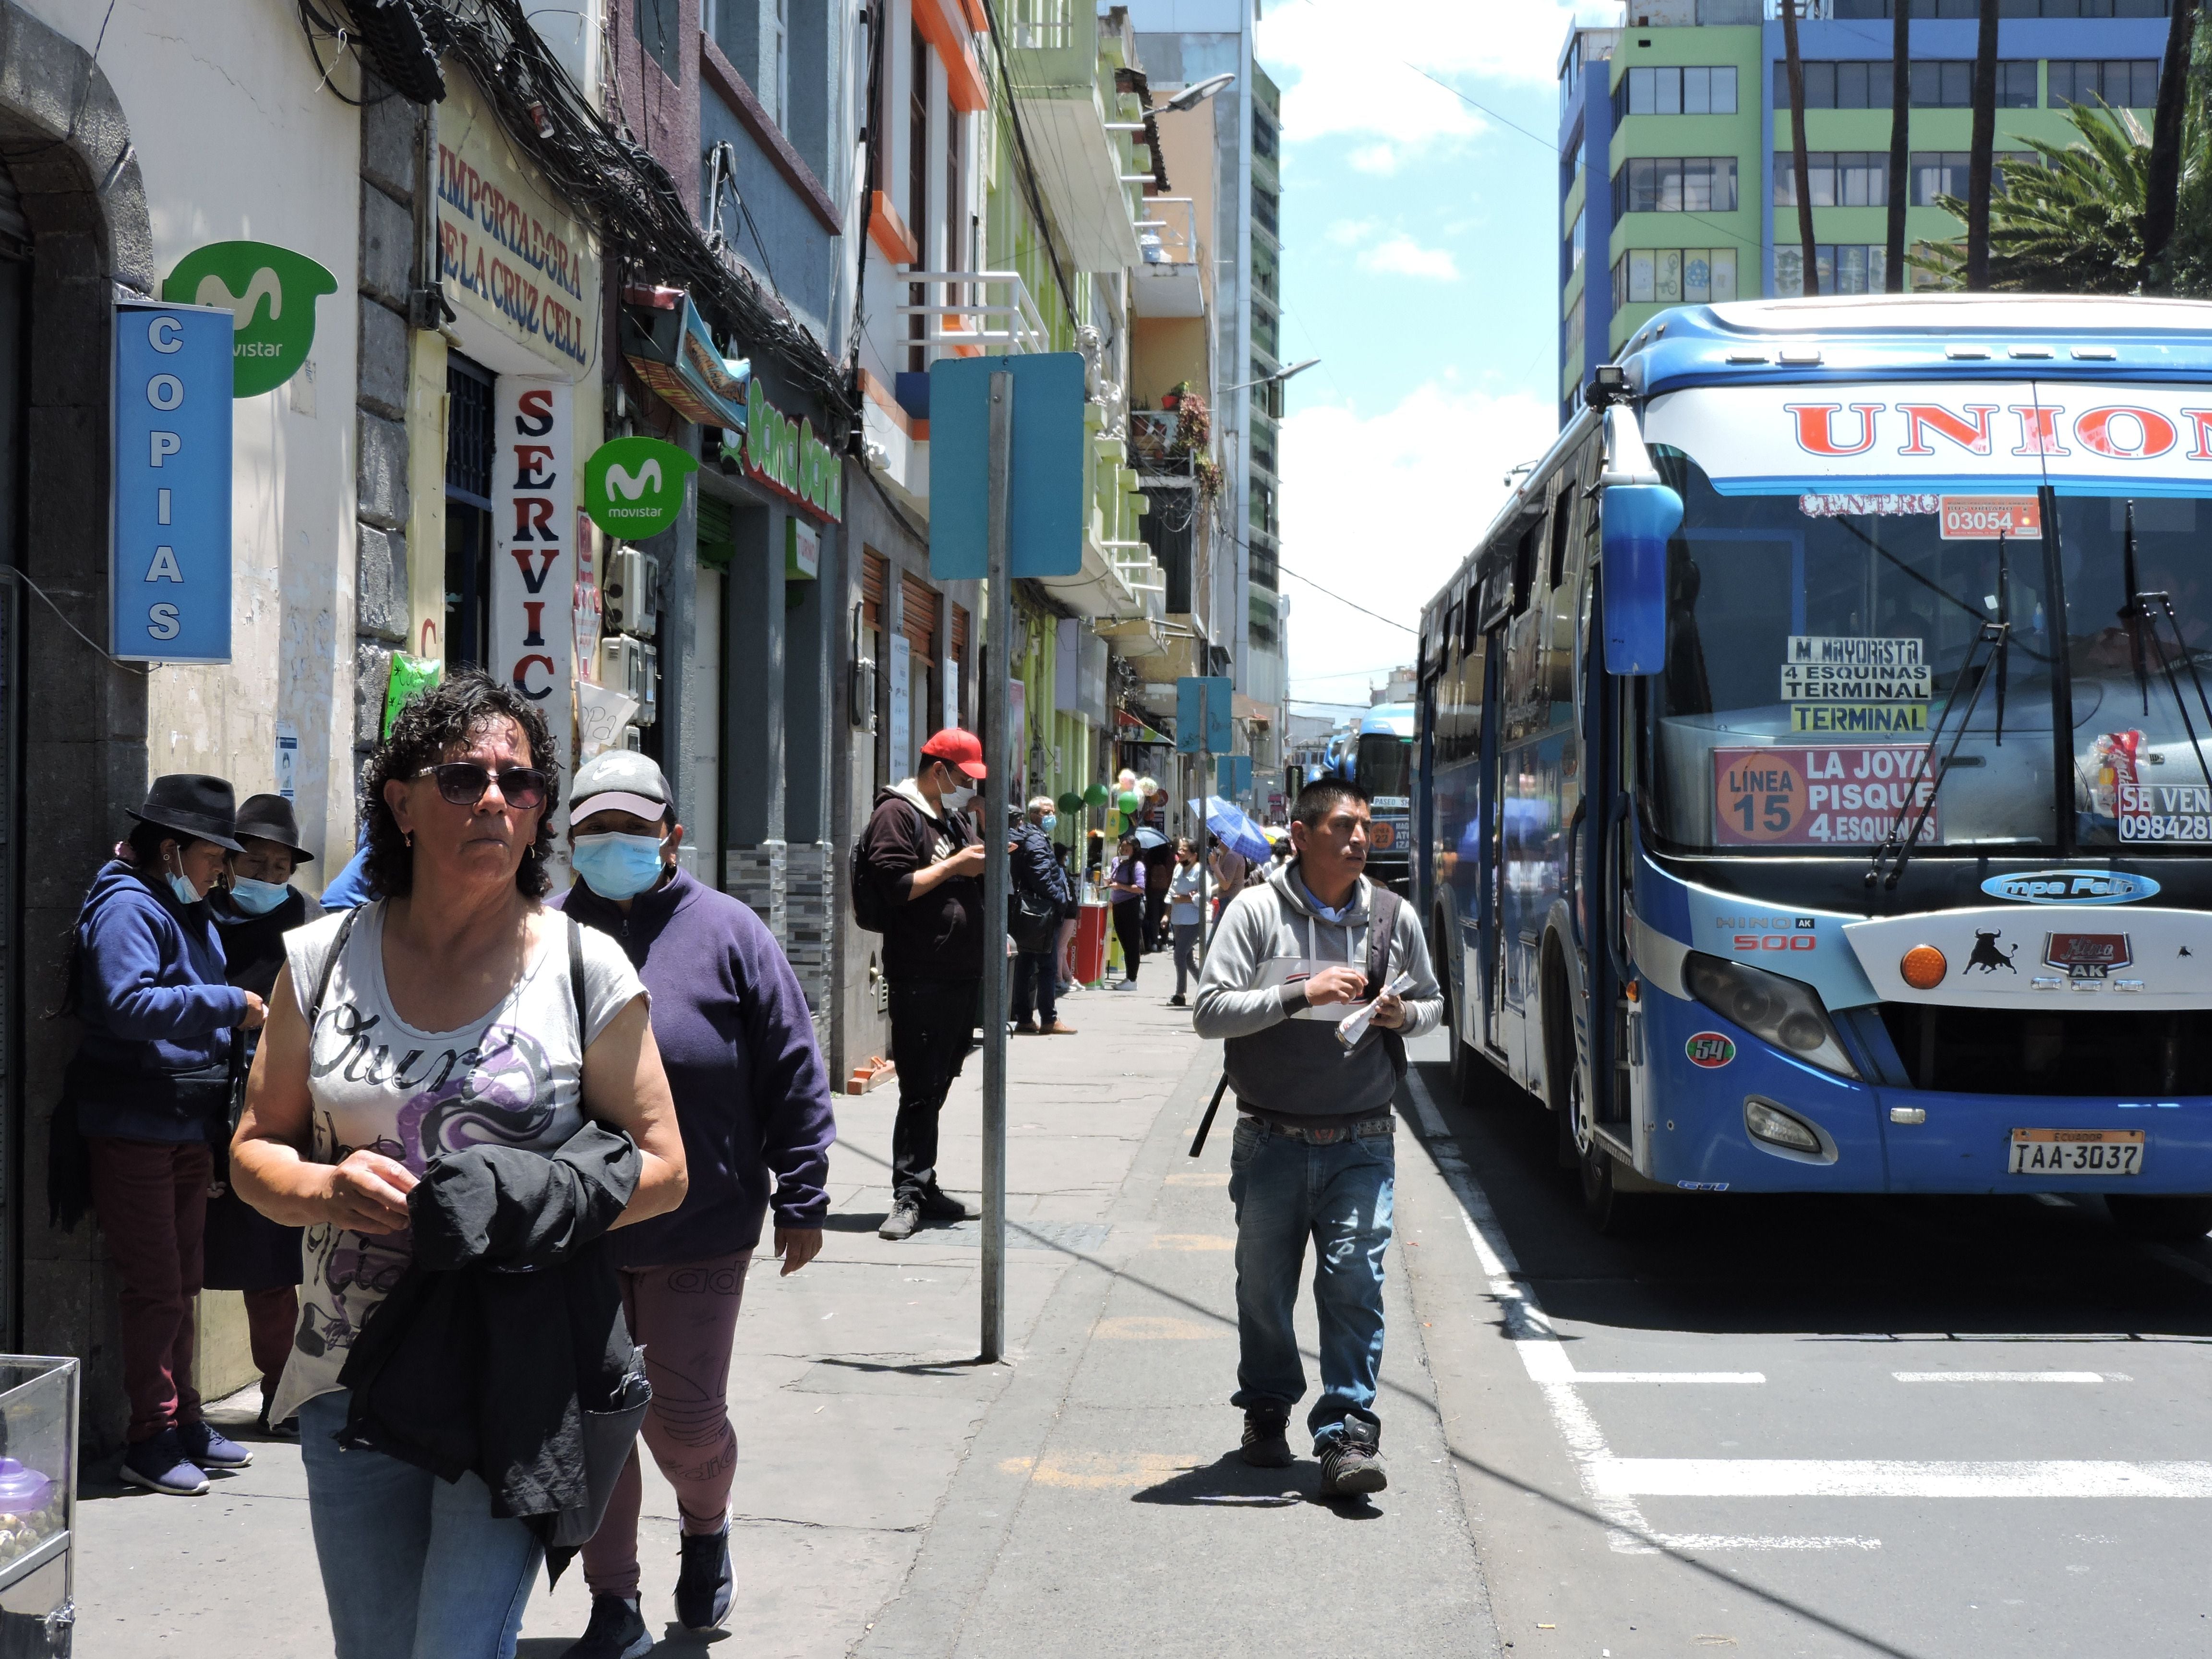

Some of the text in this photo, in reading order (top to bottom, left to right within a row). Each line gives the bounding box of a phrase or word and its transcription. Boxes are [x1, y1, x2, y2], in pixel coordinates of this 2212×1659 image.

[438, 144, 582, 301] IMPORTADORA
[491, 257, 540, 335] CRUZ
[542, 295, 586, 366] CELL
[144, 316, 184, 640] COPIAS
[608, 507, 662, 517] movistar
[1799, 494, 1939, 515] CENTRO
[1947, 512, 2013, 530] 03054
[1784, 666, 1927, 680] 4 ESQUINAS
[1786, 682, 1928, 698] TERMINAL
[1794, 707, 1924, 731] TERMINAL
[1806, 750, 1932, 779] LA JOYA
[1809, 782, 1936, 810] PISQUE
[2122, 787, 2152, 812] SE
[1733, 794, 1791, 832] 15
[1716, 917, 1791, 929] HINO
[1733, 934, 1816, 951] 500
[2060, 937, 2114, 960] Hino
[2071, 965, 2104, 977] AK
[1695, 1039, 1726, 1061] 54
[2055, 1133, 2103, 1142] ECUADOR
[2017, 1145, 2138, 1169] TAA-3037
